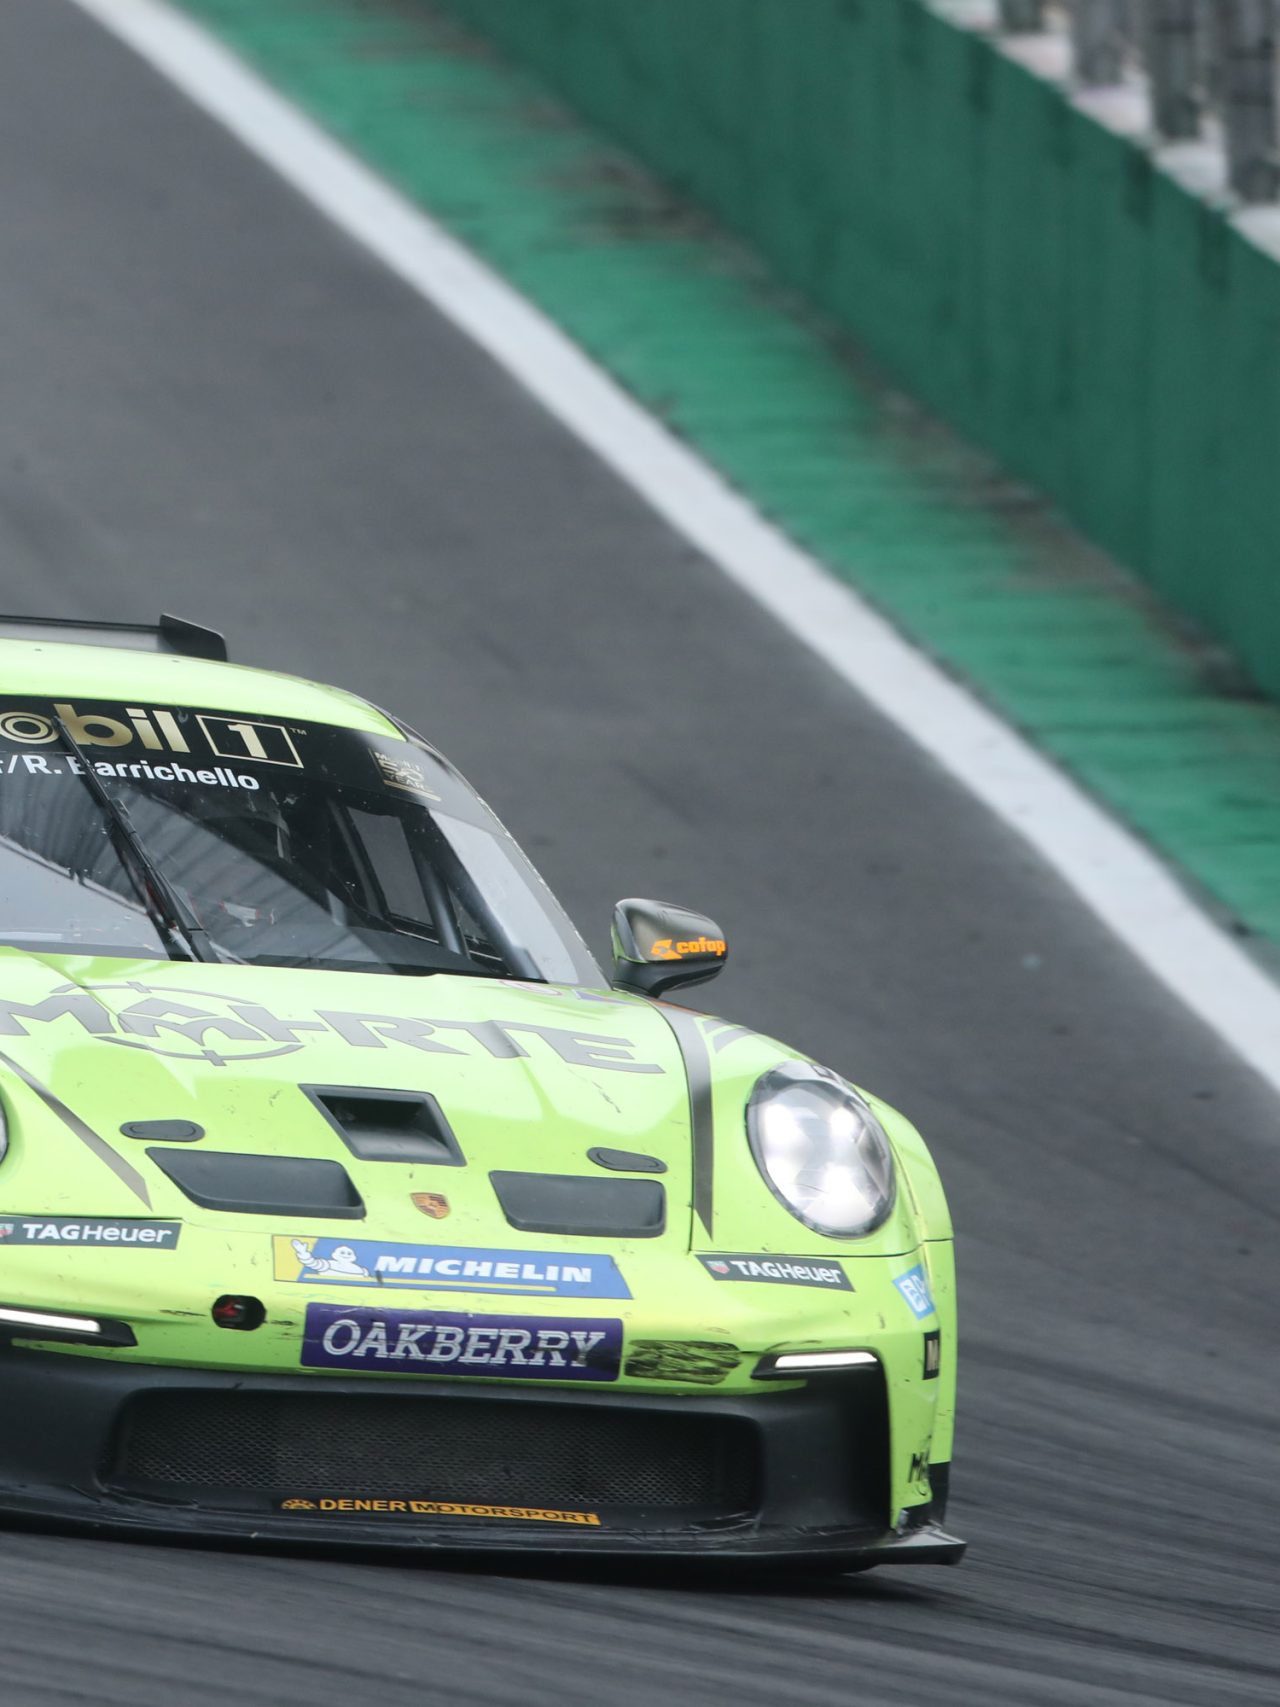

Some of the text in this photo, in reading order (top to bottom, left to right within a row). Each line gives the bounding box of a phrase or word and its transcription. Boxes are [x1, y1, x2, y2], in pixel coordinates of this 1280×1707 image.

[227, 723, 268, 759] 1
[676, 936, 726, 956] cofap
[374, 1254, 592, 1283] MICHELIN
[322, 1318, 605, 1369] OAKBERRY
[320, 1499, 595, 1523] DENER MOTORSPORT
